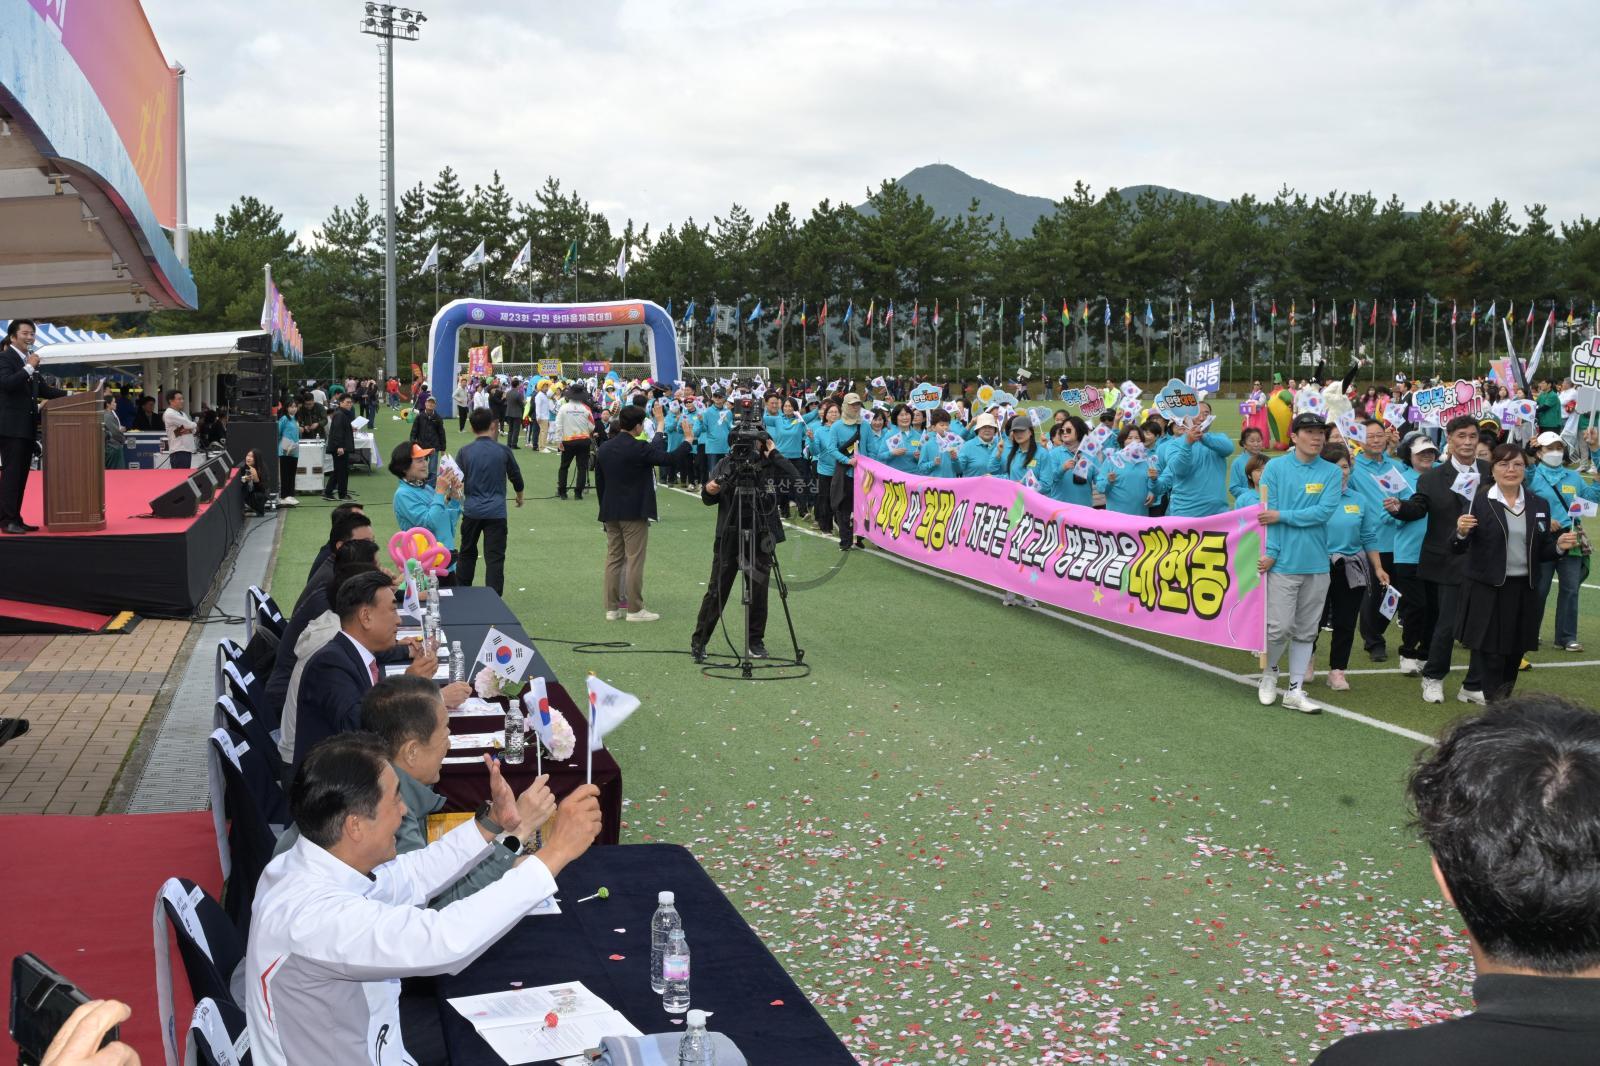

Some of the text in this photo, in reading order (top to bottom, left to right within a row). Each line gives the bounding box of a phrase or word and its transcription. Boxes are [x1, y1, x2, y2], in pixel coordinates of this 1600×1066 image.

[500, 311, 612, 323] 제23회 구민 한마음체육대회
[1186, 361, 1220, 389] 대현동
[1574, 364, 1600, 388] 대
[966, 502, 1010, 559] 자라는
[1008, 512, 1061, 572] 최고의
[1053, 524, 1140, 591] 명품마을
[1128, 525, 1231, 620] 대현동
